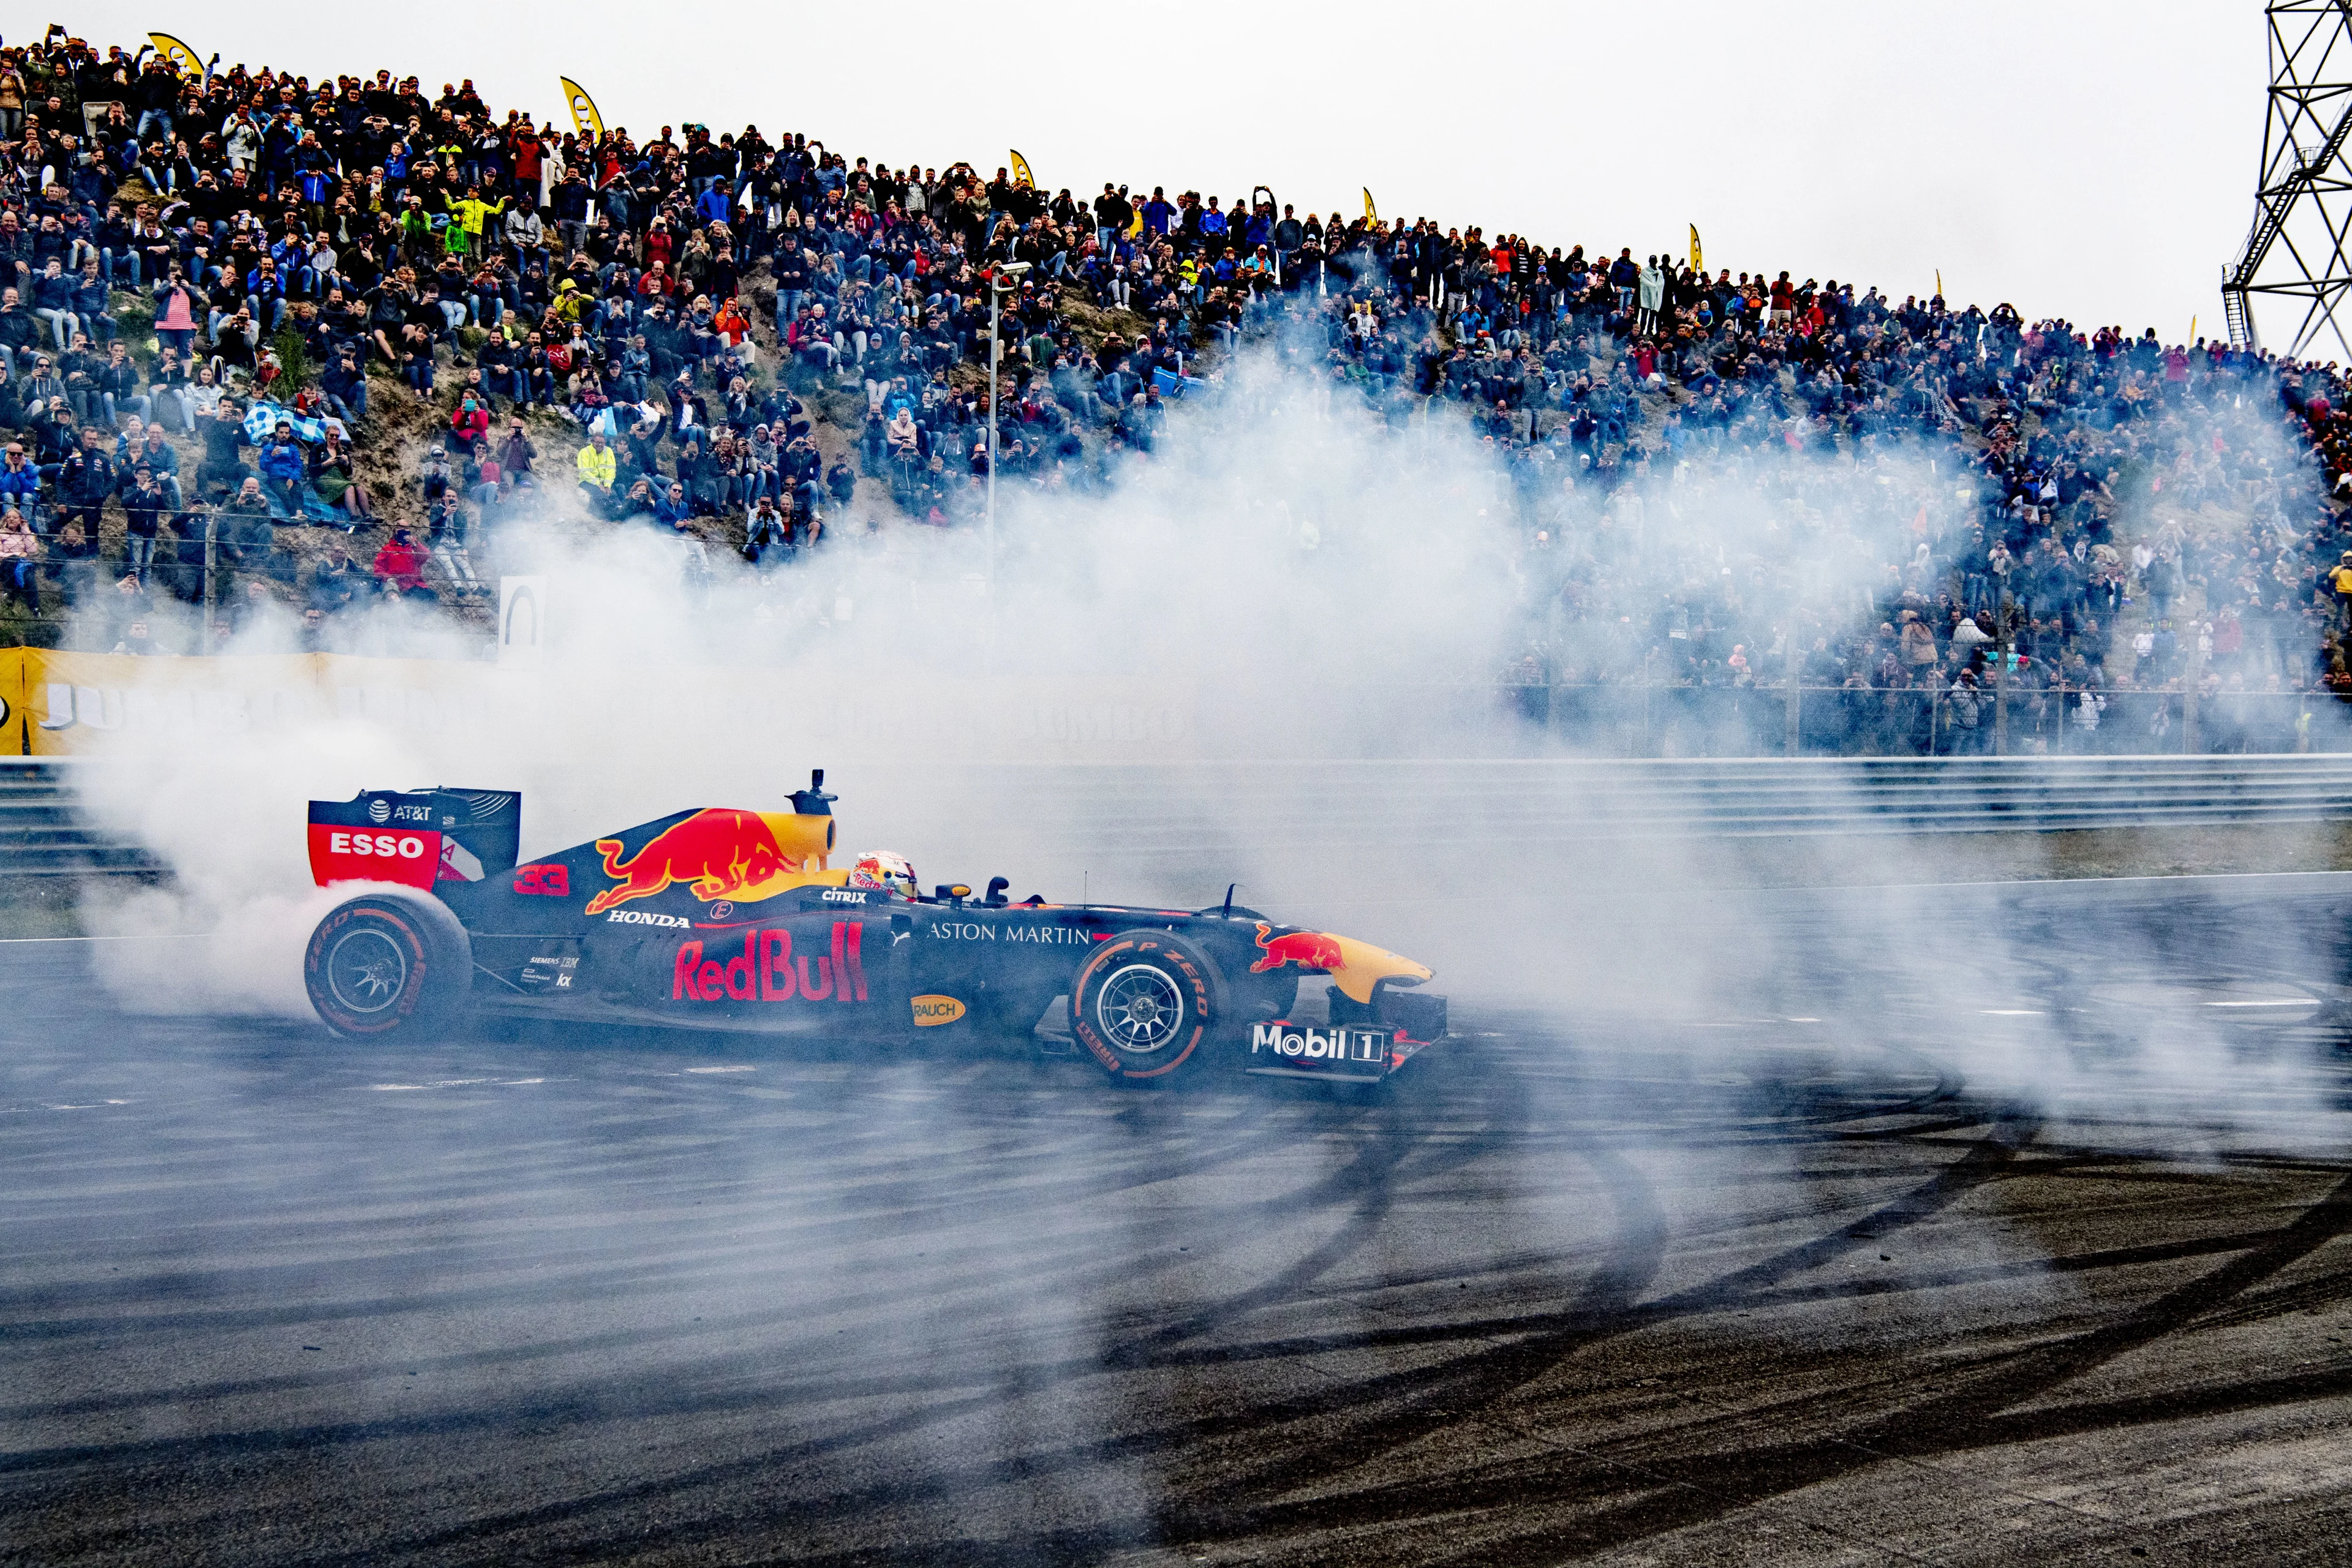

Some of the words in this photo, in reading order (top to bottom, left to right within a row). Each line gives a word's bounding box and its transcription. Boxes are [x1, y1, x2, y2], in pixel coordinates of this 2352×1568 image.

[394, 805, 432, 821] AT&T
[331, 832, 424, 859] ESSO
[513, 864, 570, 897] 33
[607, 910, 690, 929] HONDA
[926, 922, 995, 940] ASTON
[1006, 925, 1090, 945] MARTIN
[560, 957, 579, 968] IBM
[1164, 950, 1208, 1017] ZERO
[914, 1003, 956, 1017] RAUCH
[1252, 1025, 1346, 1059] Mobil
[1362, 1035, 1372, 1058] 1
